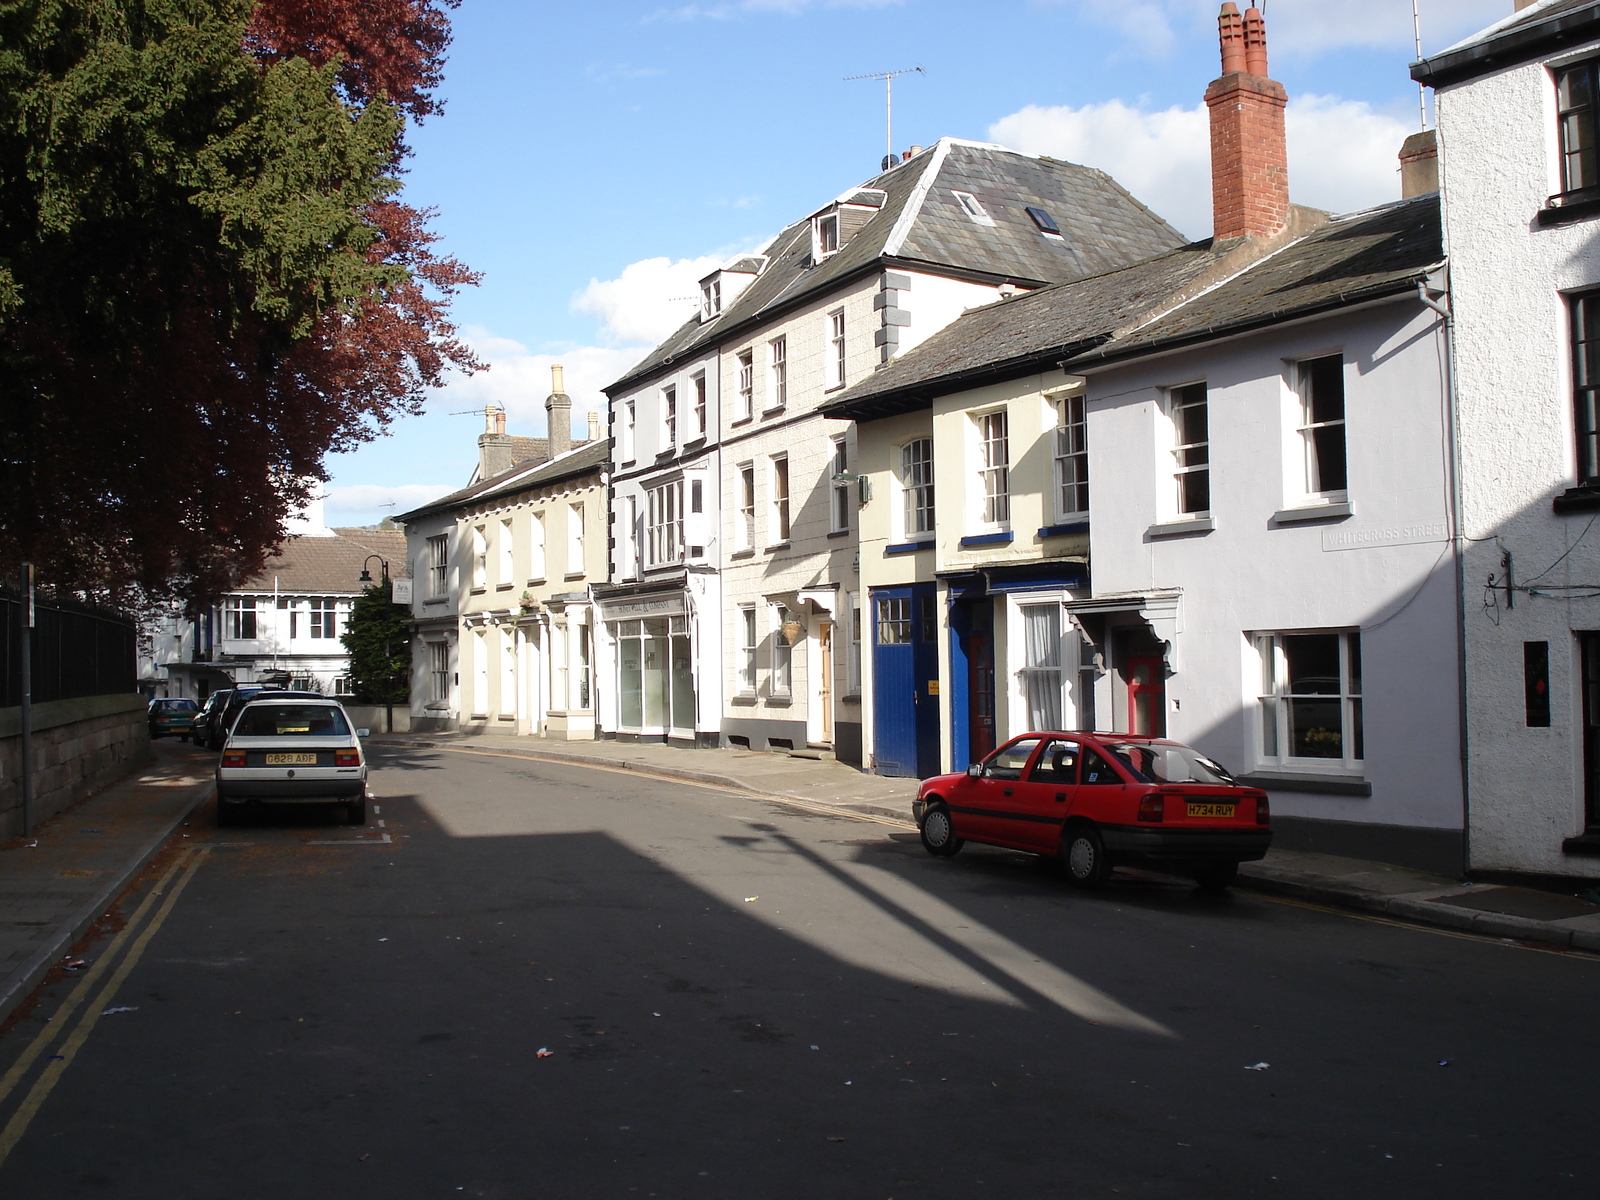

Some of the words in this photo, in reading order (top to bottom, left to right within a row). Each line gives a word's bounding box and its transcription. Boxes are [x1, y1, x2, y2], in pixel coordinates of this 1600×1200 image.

[1328, 526, 1400, 545] WHITECROSS
[1403, 523, 1447, 539] STREET
[267, 754, 293, 763] G628
[1189, 804, 1214, 815] H734
[1215, 805, 1234, 816] RUY
